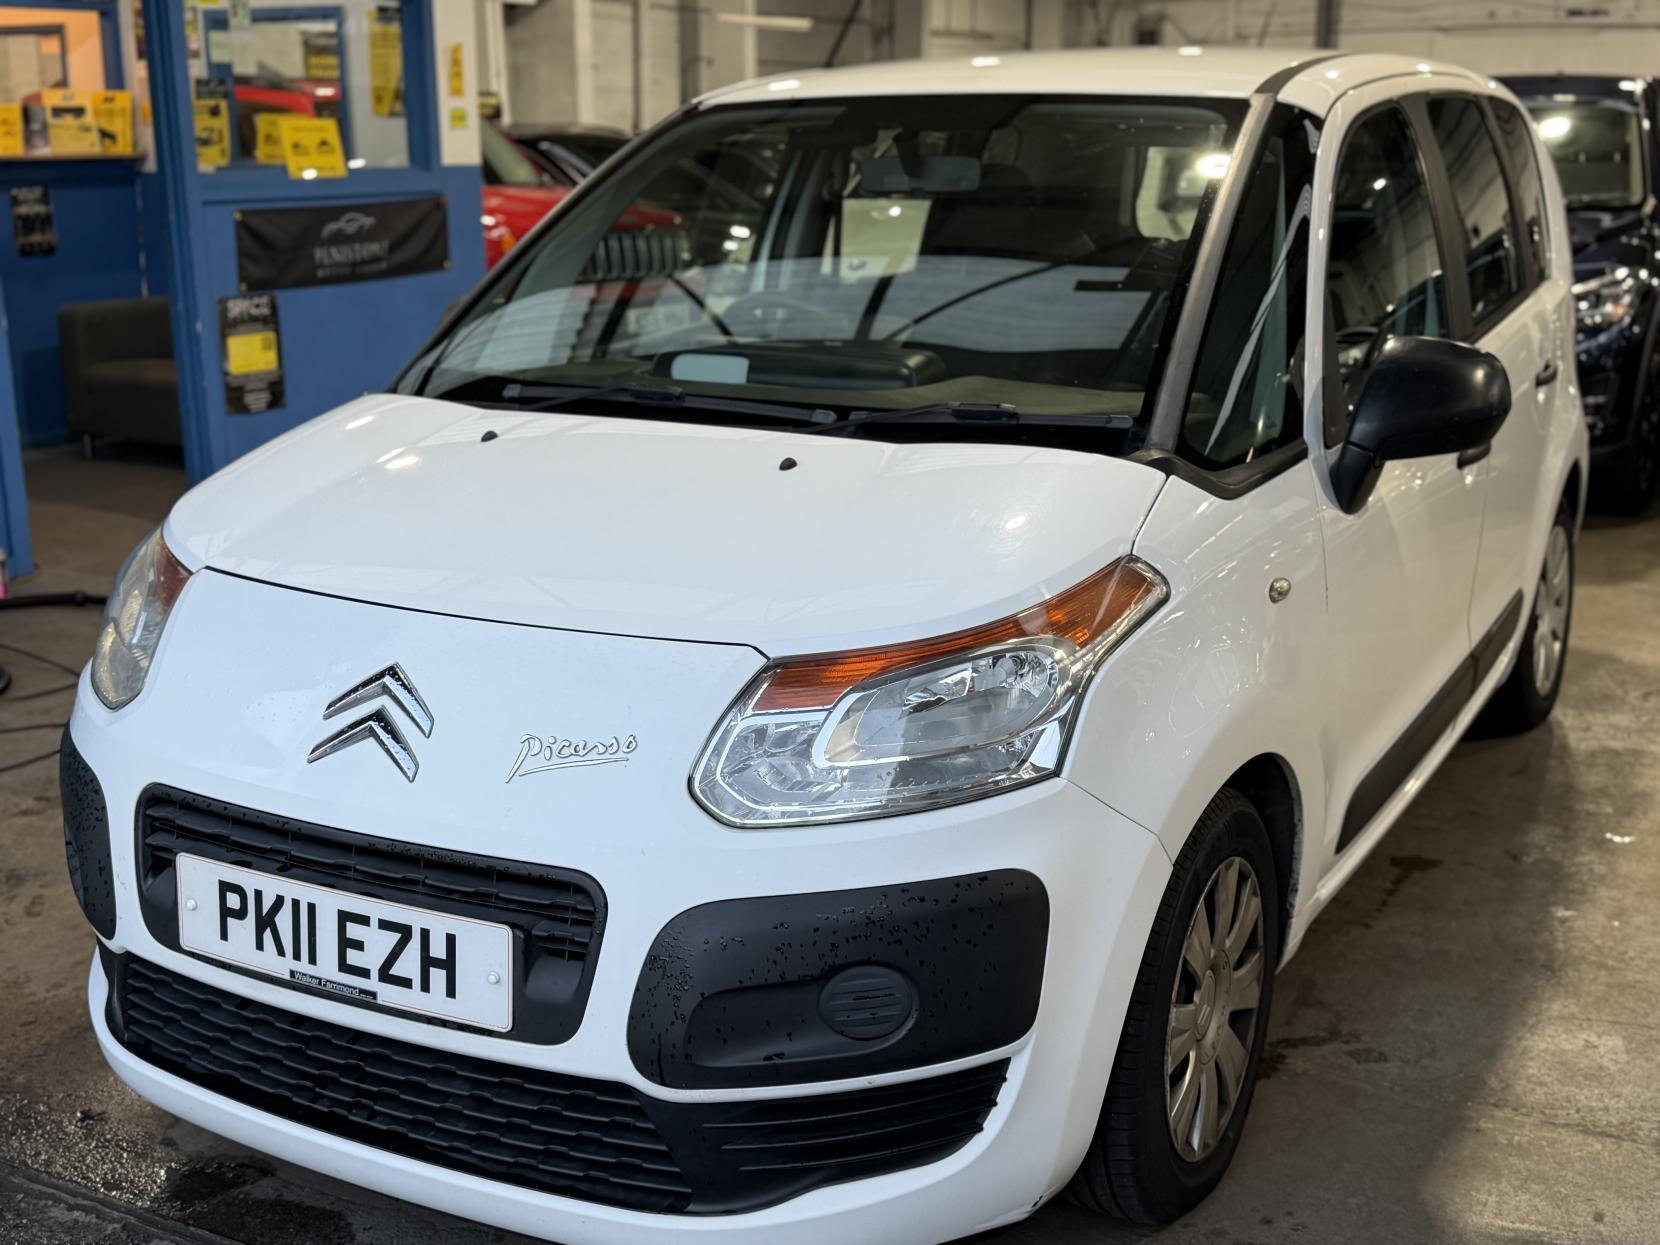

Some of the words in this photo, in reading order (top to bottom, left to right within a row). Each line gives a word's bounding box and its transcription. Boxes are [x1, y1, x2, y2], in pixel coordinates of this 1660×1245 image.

[505, 733, 638, 784] Picasso
[218, 879, 317, 966] PK11
[337, 909, 457, 1000] EZH
[294, 971, 319, 985] Walker
